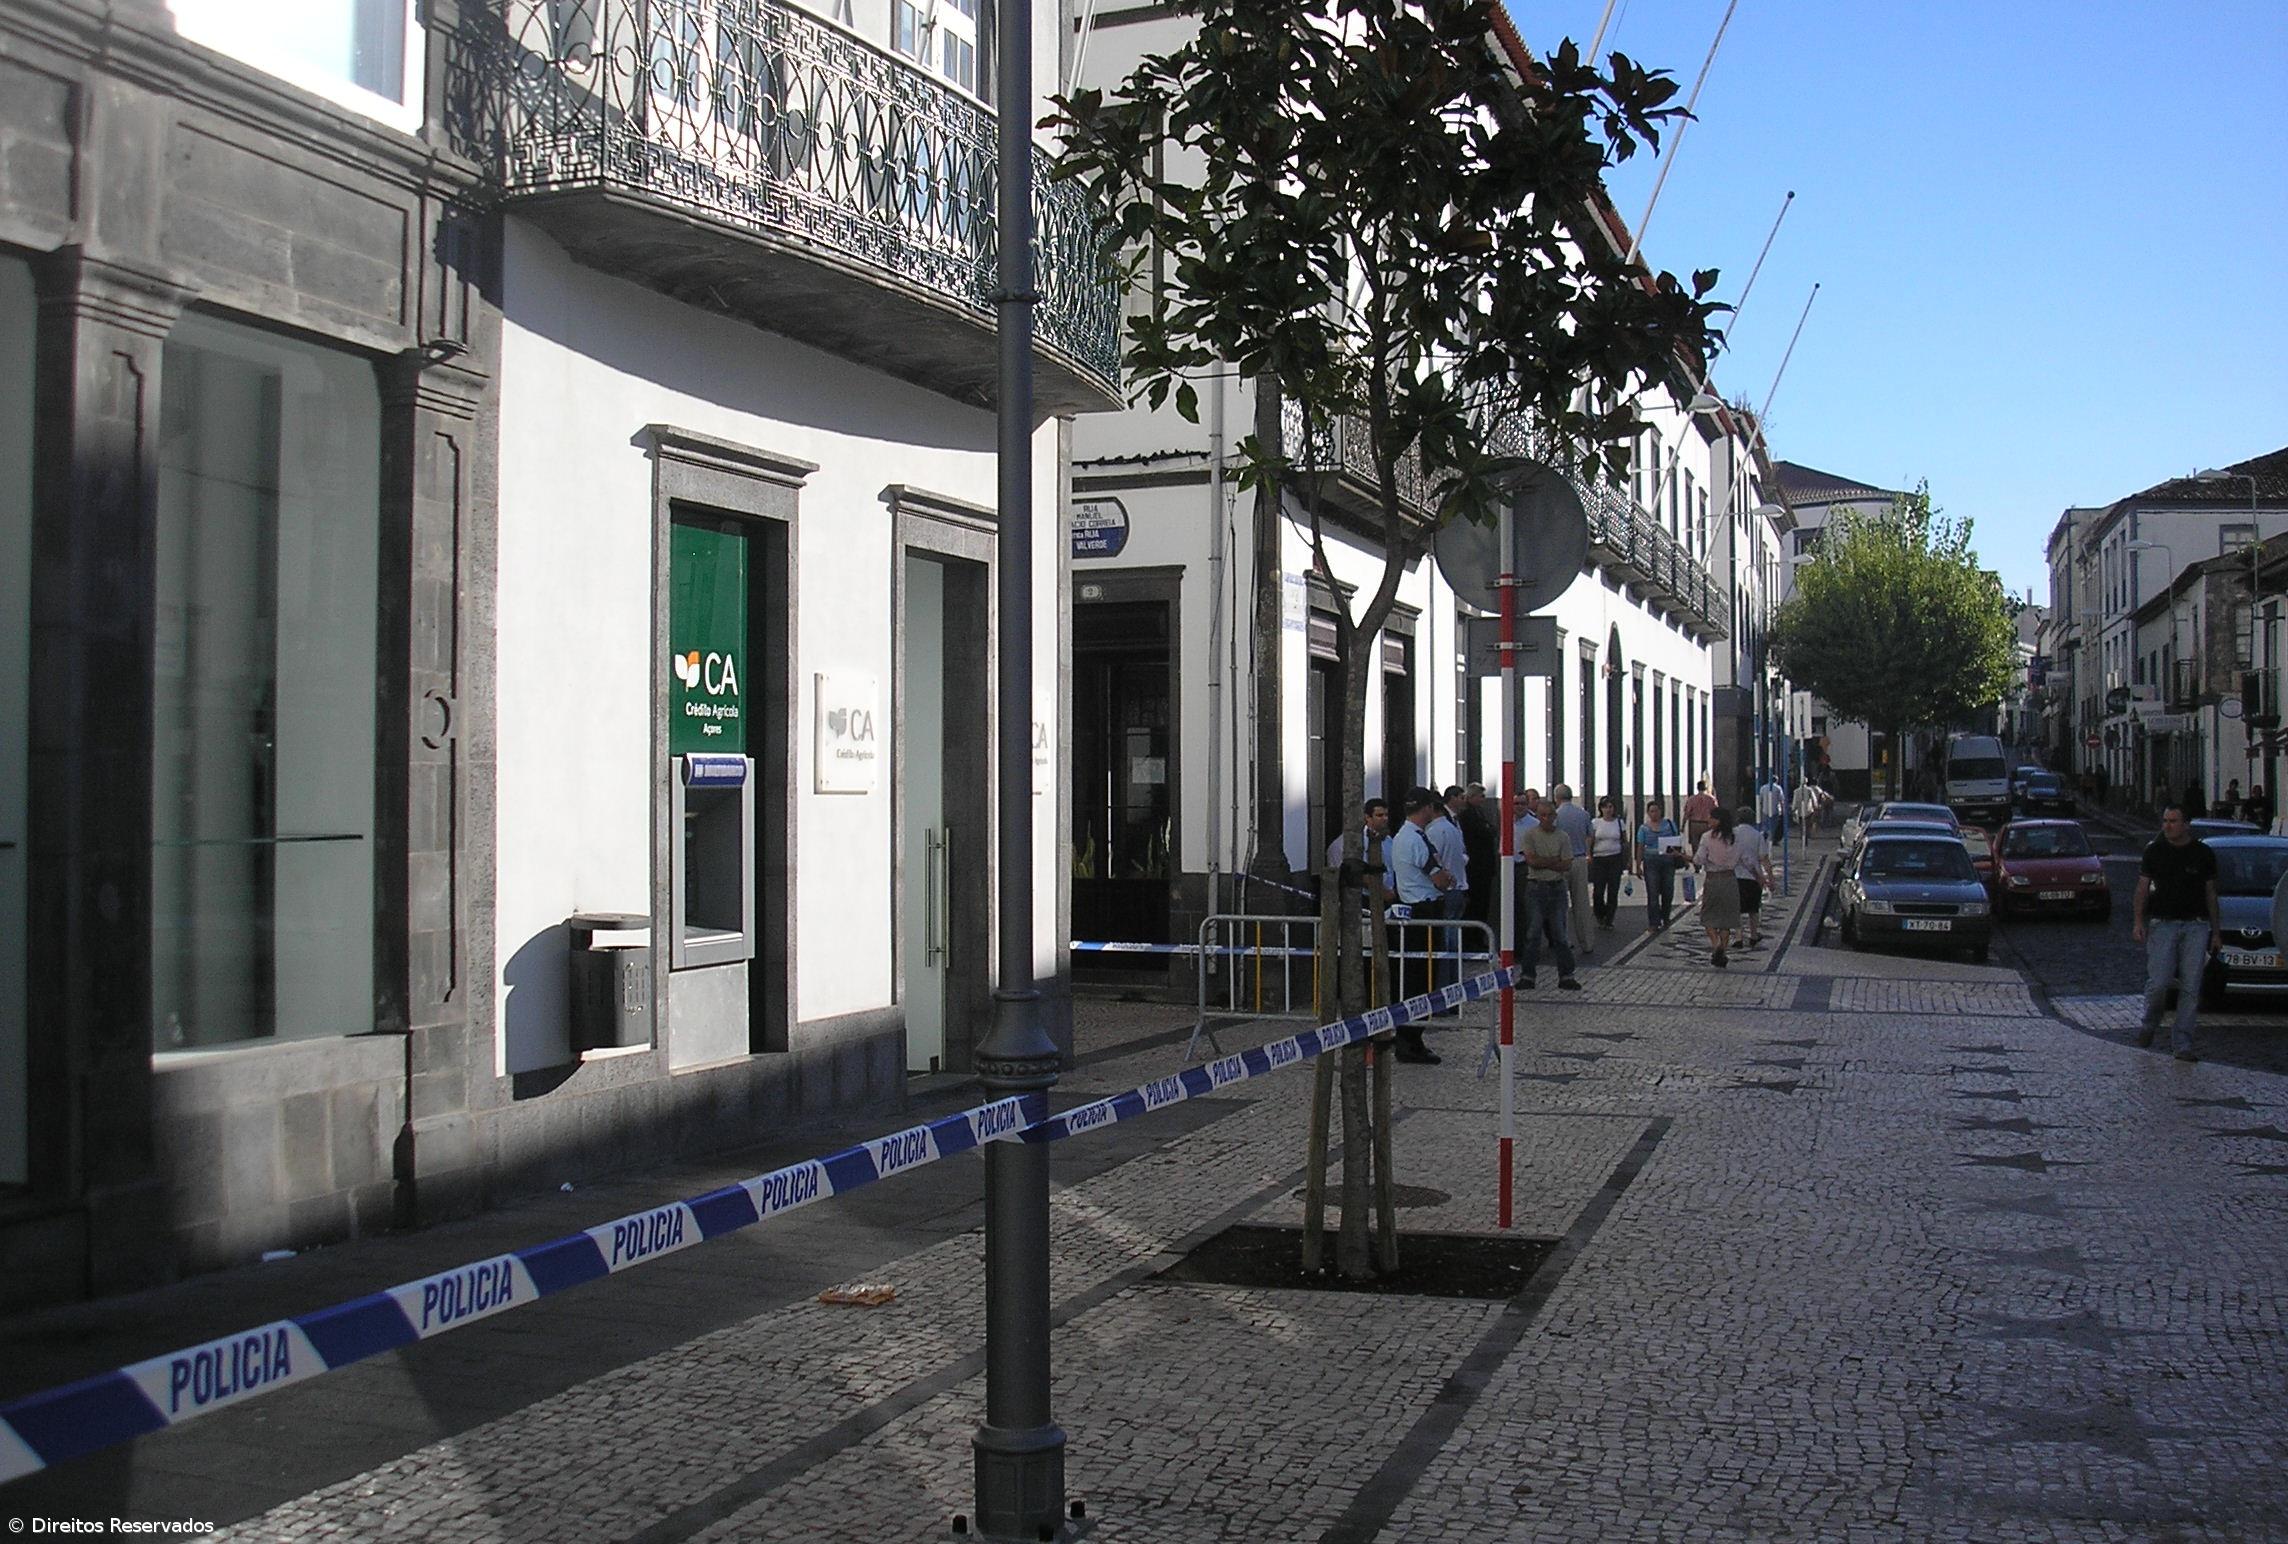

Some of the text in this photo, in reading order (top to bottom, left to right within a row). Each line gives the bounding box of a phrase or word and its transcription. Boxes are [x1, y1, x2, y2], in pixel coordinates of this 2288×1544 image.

[1084, 530, 1099, 538] RUA
[705, 652, 739, 696] CA
[686, 702, 739, 720] Crédito Agrícola
[851, 709, 874, 741] CA
[703, 723, 723, 736] Açores
[1270, 1038, 1297, 1065] POLICIA
[1212, 1055, 1242, 1085] POLICIA
[1146, 1074, 1180, 1107] POLICIA
[977, 1100, 1016, 1139] POLICIA
[880, 1129, 927, 1173] POLICIA
[761, 1162, 819, 1215] POLICIA
[612, 1206, 684, 1265] POLICIA
[422, 1260, 513, 1329] POLICIA
[170, 1328, 292, 1413] POLICIA
